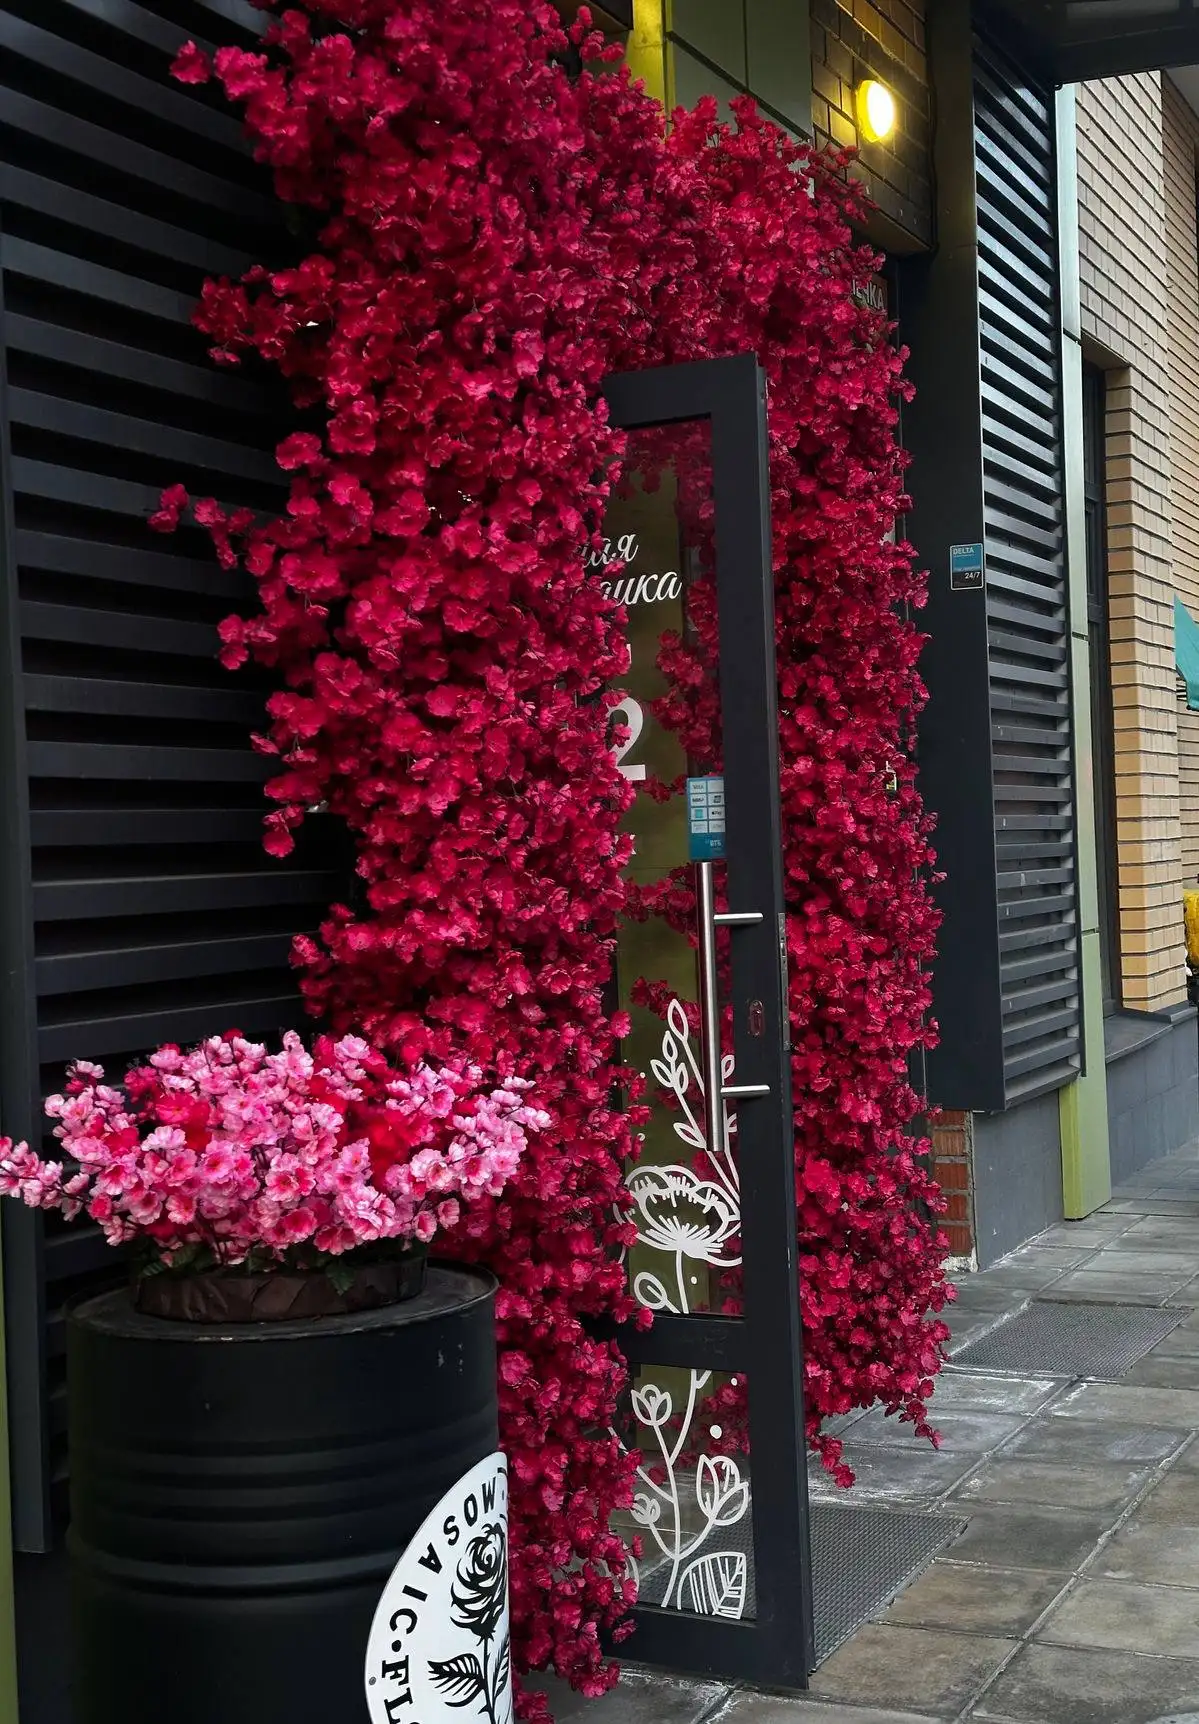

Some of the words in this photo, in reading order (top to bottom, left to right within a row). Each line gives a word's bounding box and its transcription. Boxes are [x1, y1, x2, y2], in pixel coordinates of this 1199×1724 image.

[953, 547, 975, 555] DELTA
[964, 571, 980, 579] 24/7
[381, 1654, 421, 1724] FL
